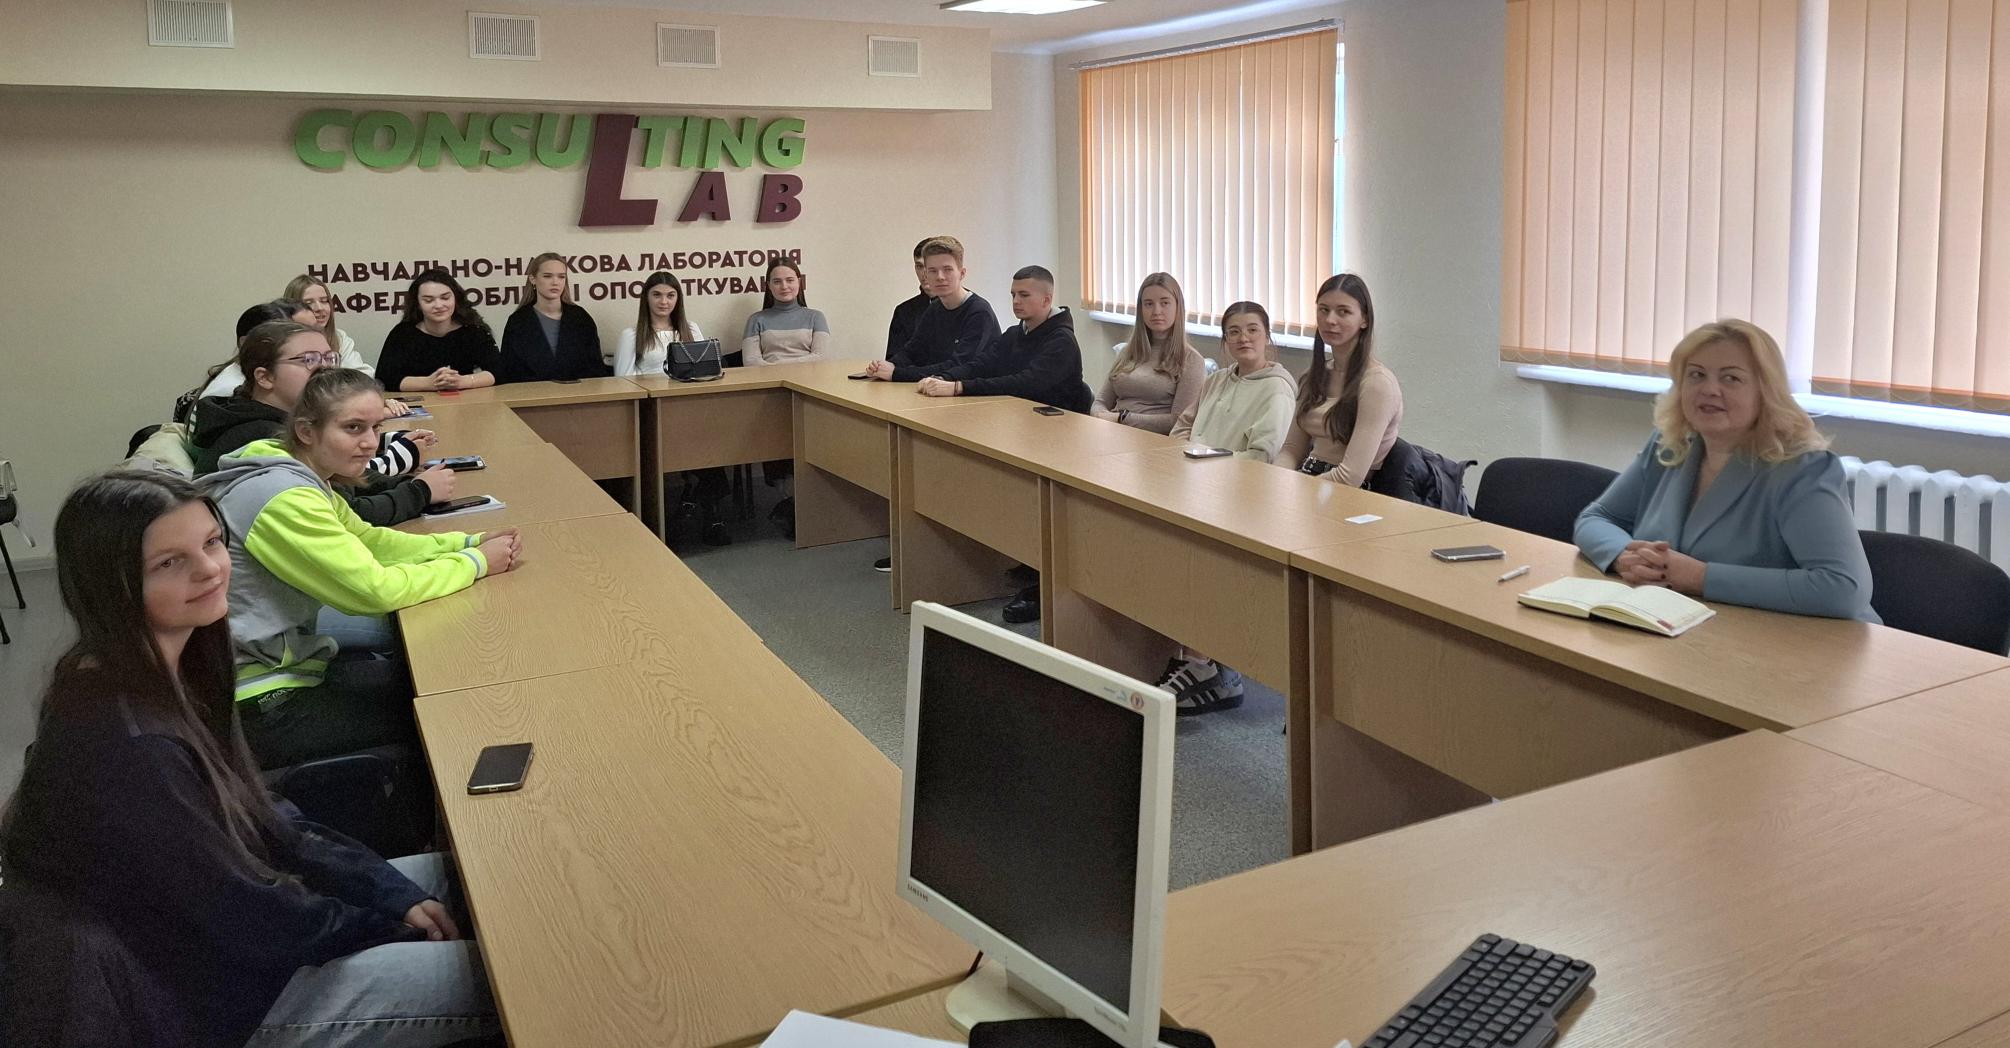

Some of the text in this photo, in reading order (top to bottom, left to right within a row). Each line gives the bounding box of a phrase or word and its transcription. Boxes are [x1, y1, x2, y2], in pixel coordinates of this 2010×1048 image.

[295, 108, 806, 227] CONSULTING
[578, 113, 805, 227] LAB
[308, 254, 632, 283] НАВЧАЛЬНО-НКОВА
[331, 291, 410, 314] АФЕД
[589, 274, 806, 301] ОПОТКУВА
